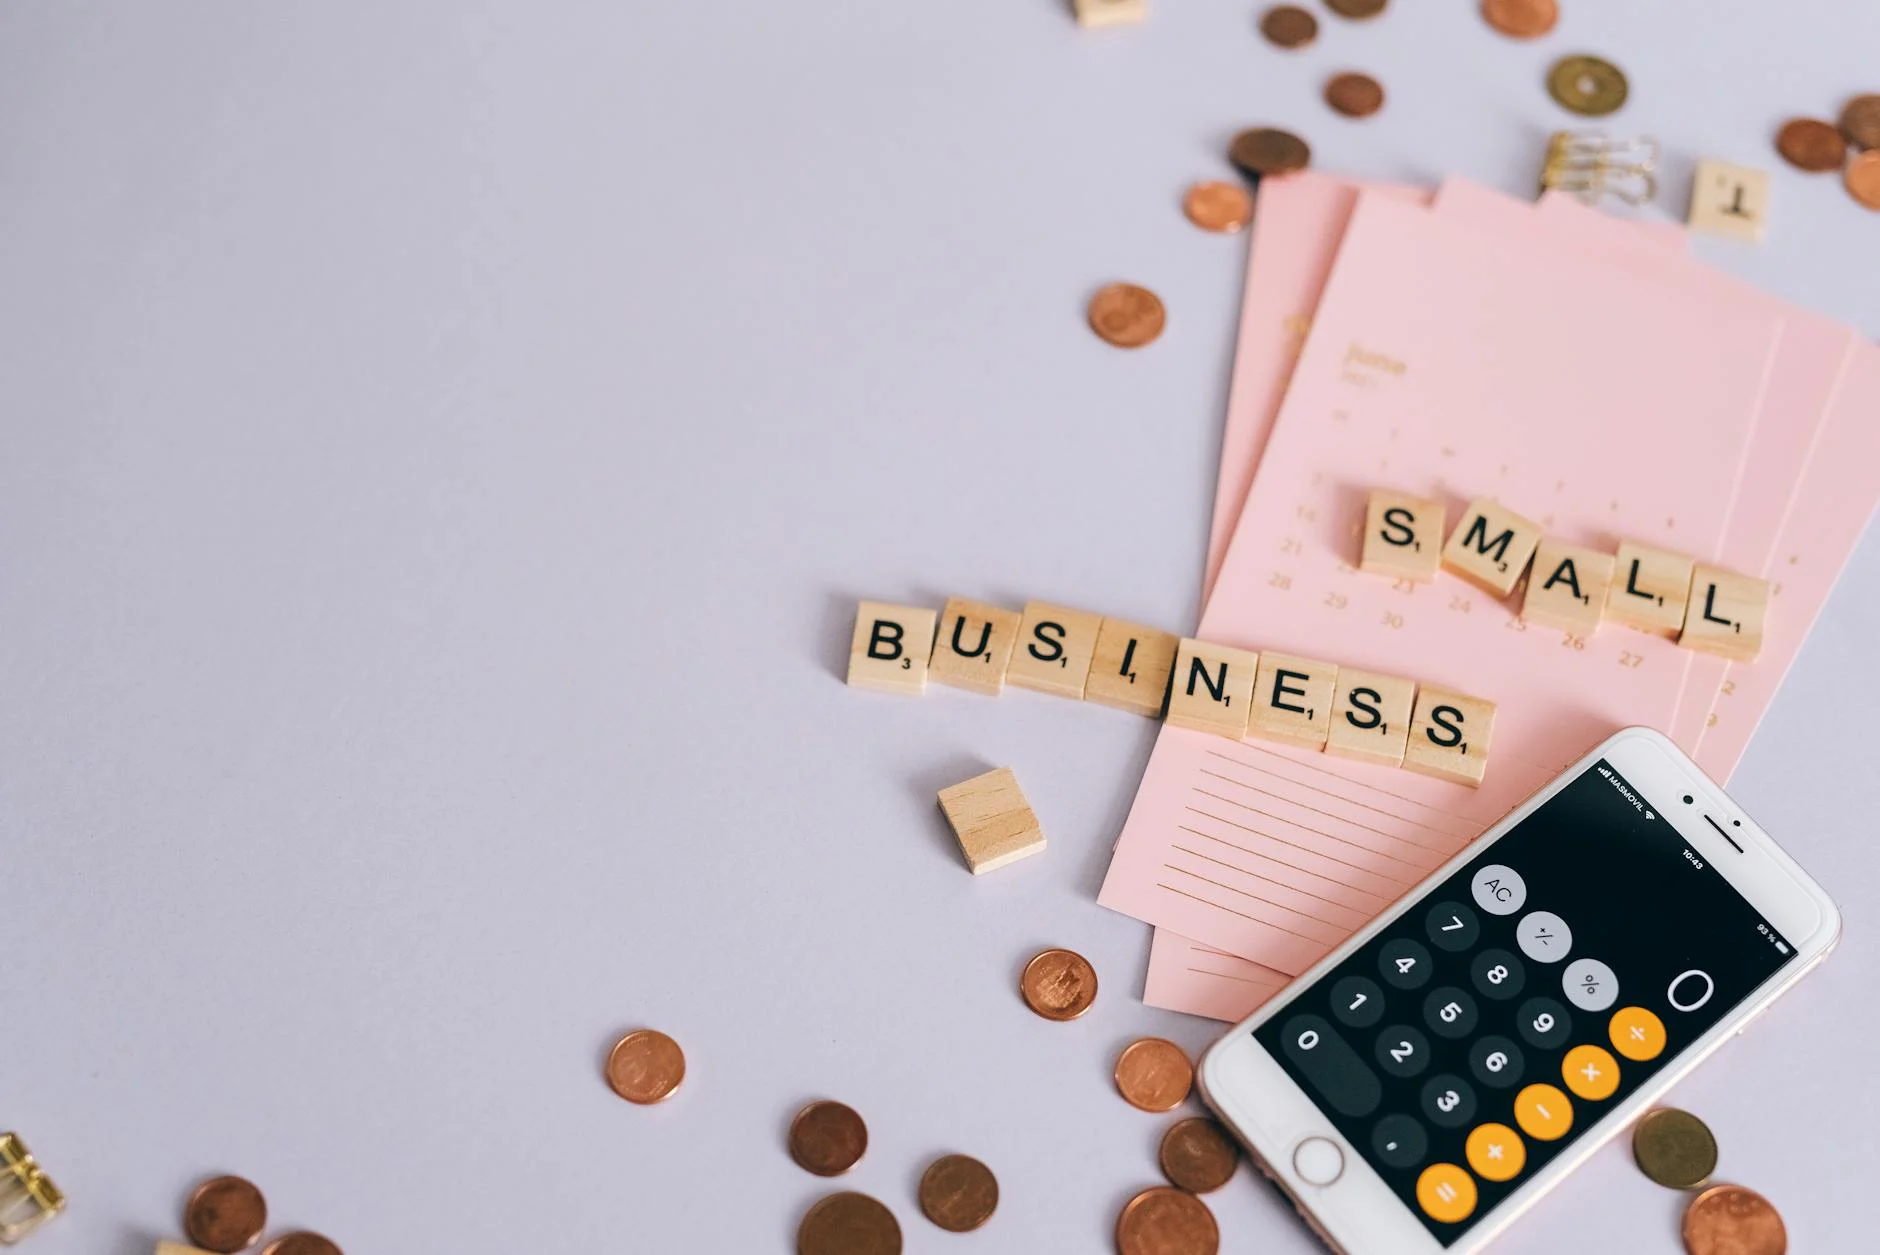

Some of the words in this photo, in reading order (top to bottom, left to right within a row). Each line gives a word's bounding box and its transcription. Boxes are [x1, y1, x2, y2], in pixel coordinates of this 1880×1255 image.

[1380, 507, 1732, 627] SMALL
[1581, 595, 1590, 606] 1
[1658, 596, 1665, 608] 1
[1734, 622, 1741, 634] 1
[1618, 650, 1644, 668] 27
[867, 616, 1466, 748] BUSINESS
[902, 657, 911, 670] 3
[984, 652, 992, 664] 1
[1060, 656, 1068, 669] 1
[1128, 672, 1137, 684] 1
[1222, 695, 1231, 708] 1
[1306, 708, 1315, 721] 1
[1380, 723, 1388, 736] 1
[1459, 742, 1468, 755] 1
[1608, 775, 1645, 813] MASMOVIL
[1682, 848, 1705, 871] 10:43
[1483, 879, 1513, 903] AC
[1441, 915, 1465, 932] 7
[1756, 923, 1769, 936] 93
[1395, 956, 1417, 974] 4
[1487, 964, 1509, 985] 8
[1349, 993, 1368, 1011] 1
[1667, 969, 1715, 1013] 0
[1439, 1001, 1463, 1023] 5
[1533, 1012, 1555, 1033] 9
[1297, 1030, 1320, 1051] 0
[1390, 1040, 1414, 1064] 2
[1485, 1051, 1509, 1073] 6
[1437, 1090, 1461, 1113] 3
